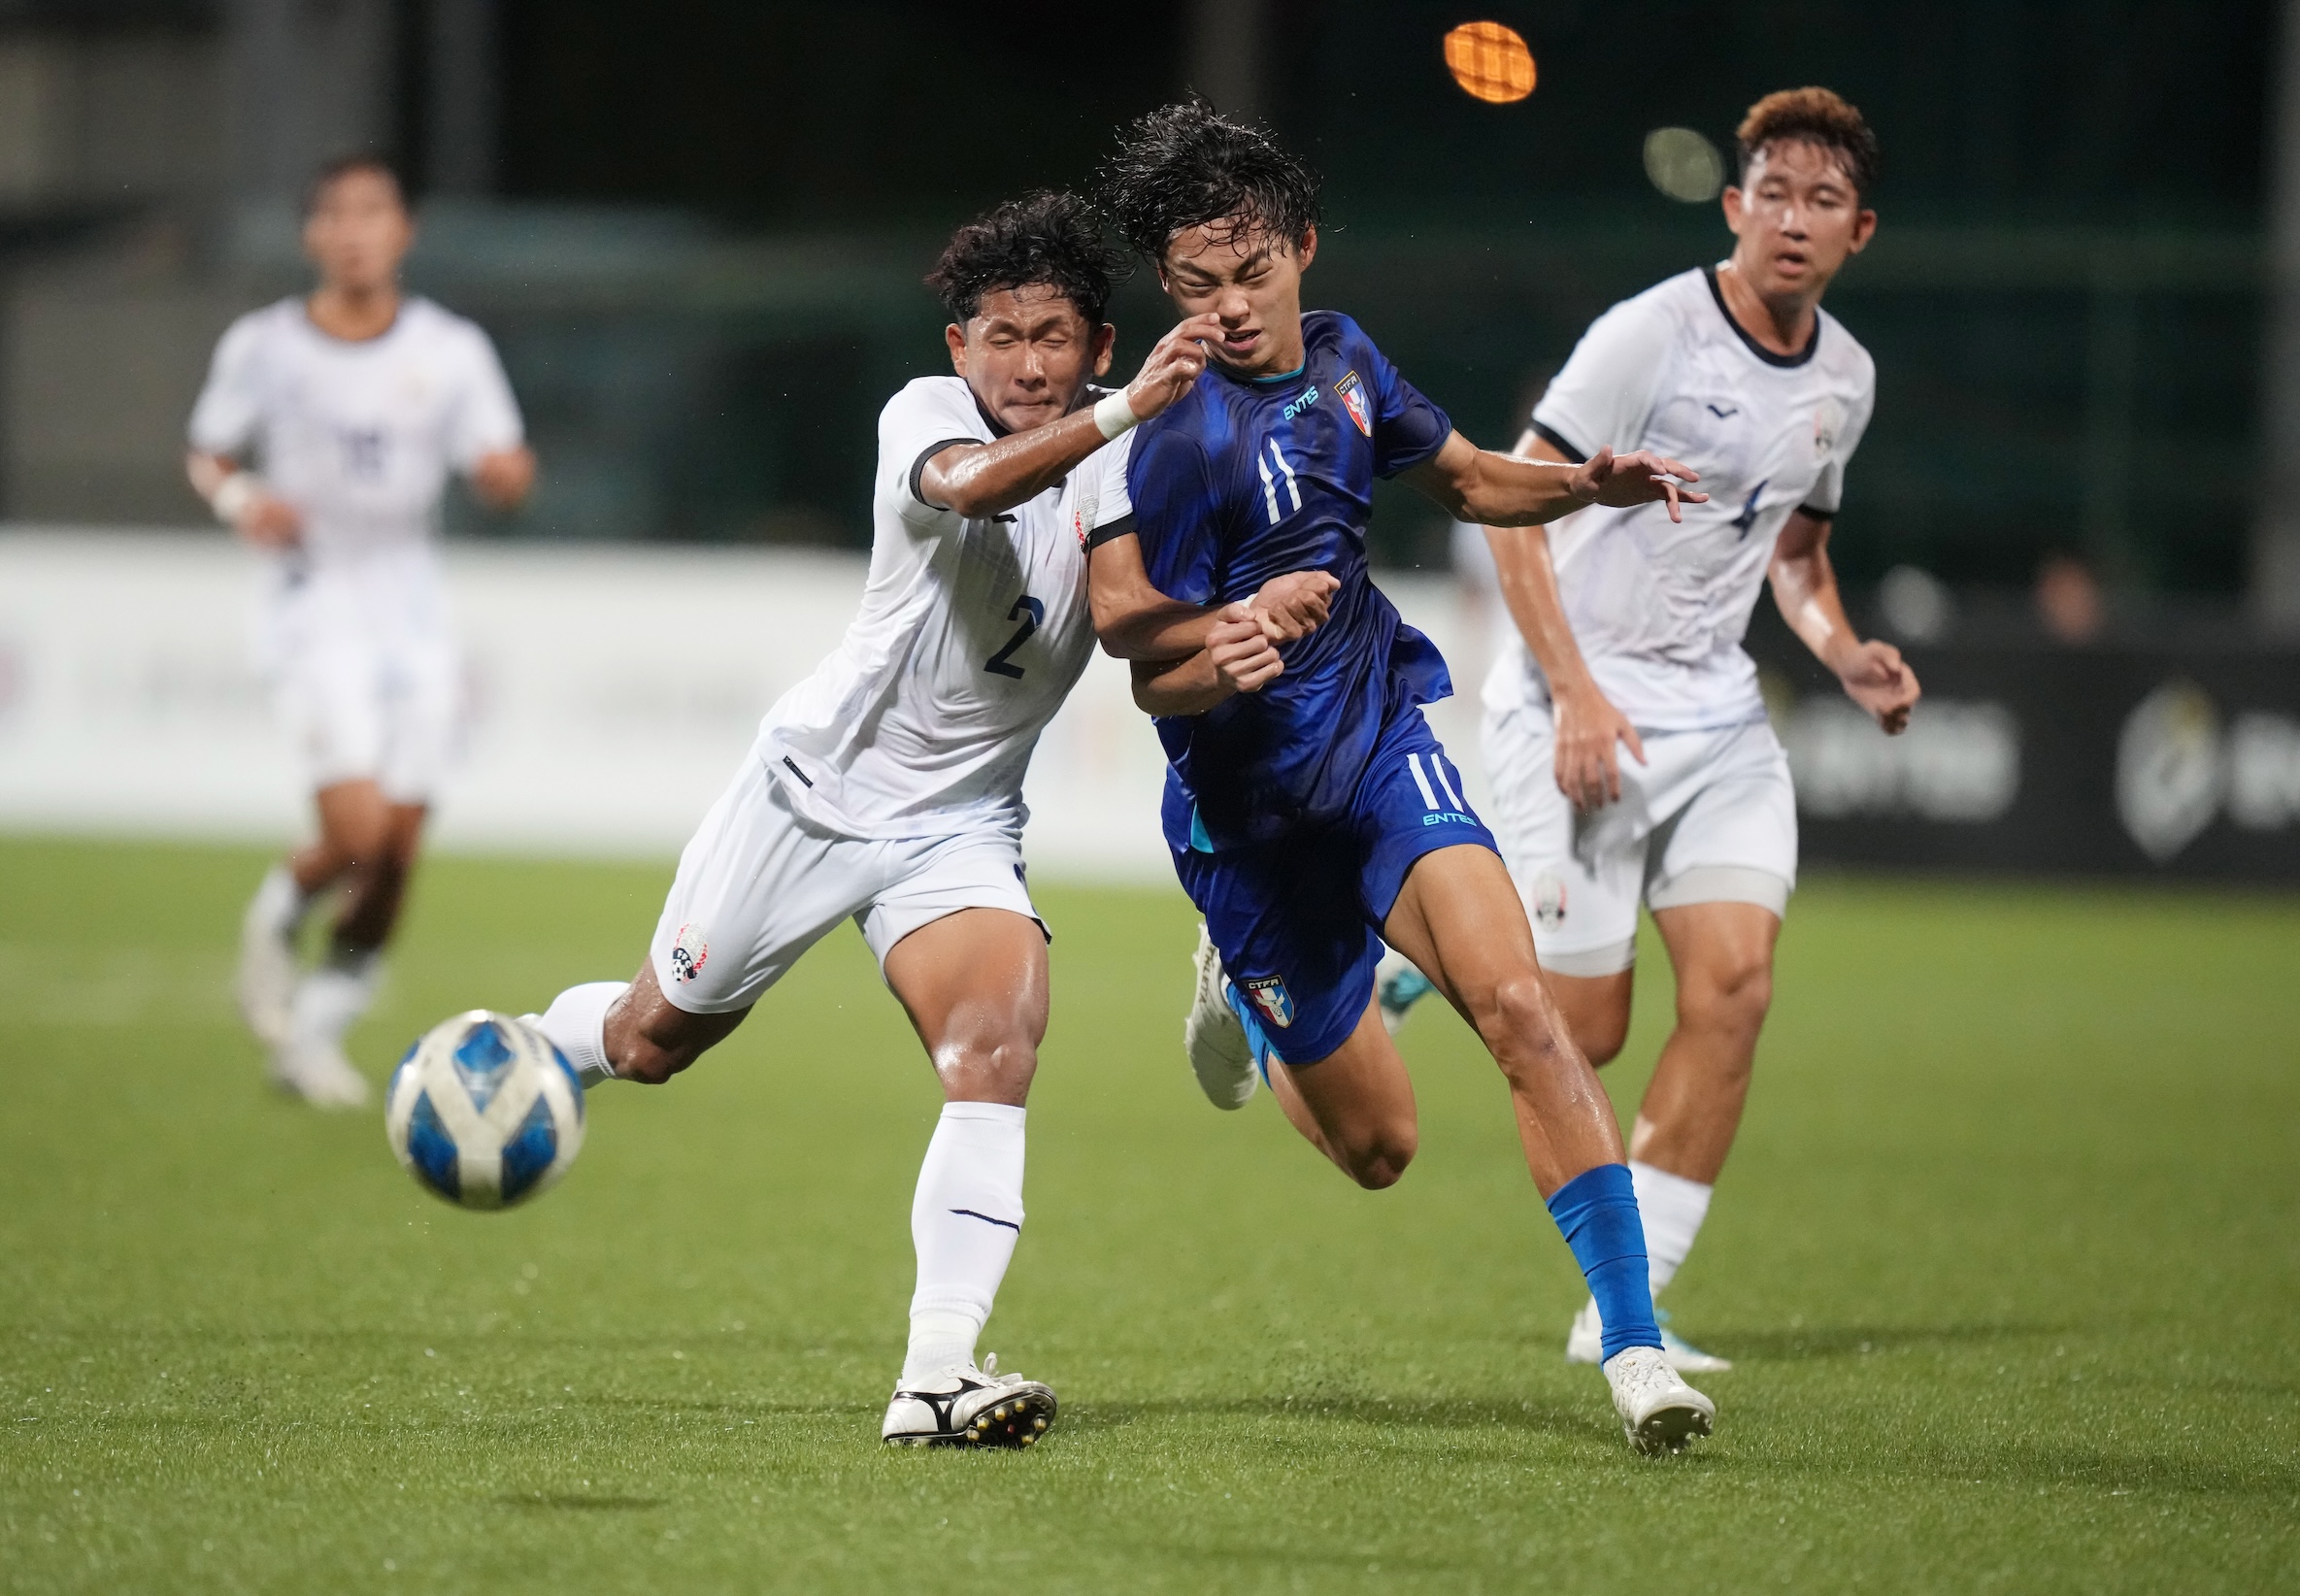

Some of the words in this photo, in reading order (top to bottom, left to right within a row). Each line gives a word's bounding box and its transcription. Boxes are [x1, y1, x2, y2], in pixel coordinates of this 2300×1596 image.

[1283, 385, 1318, 420] ENTES
[1340, 376, 1357, 394] CTFA
[1258, 437, 1302, 525] 11
[983, 594, 1044, 680] 2
[1406, 752, 1464, 814] 11
[1248, 979, 1279, 989] CTFA
